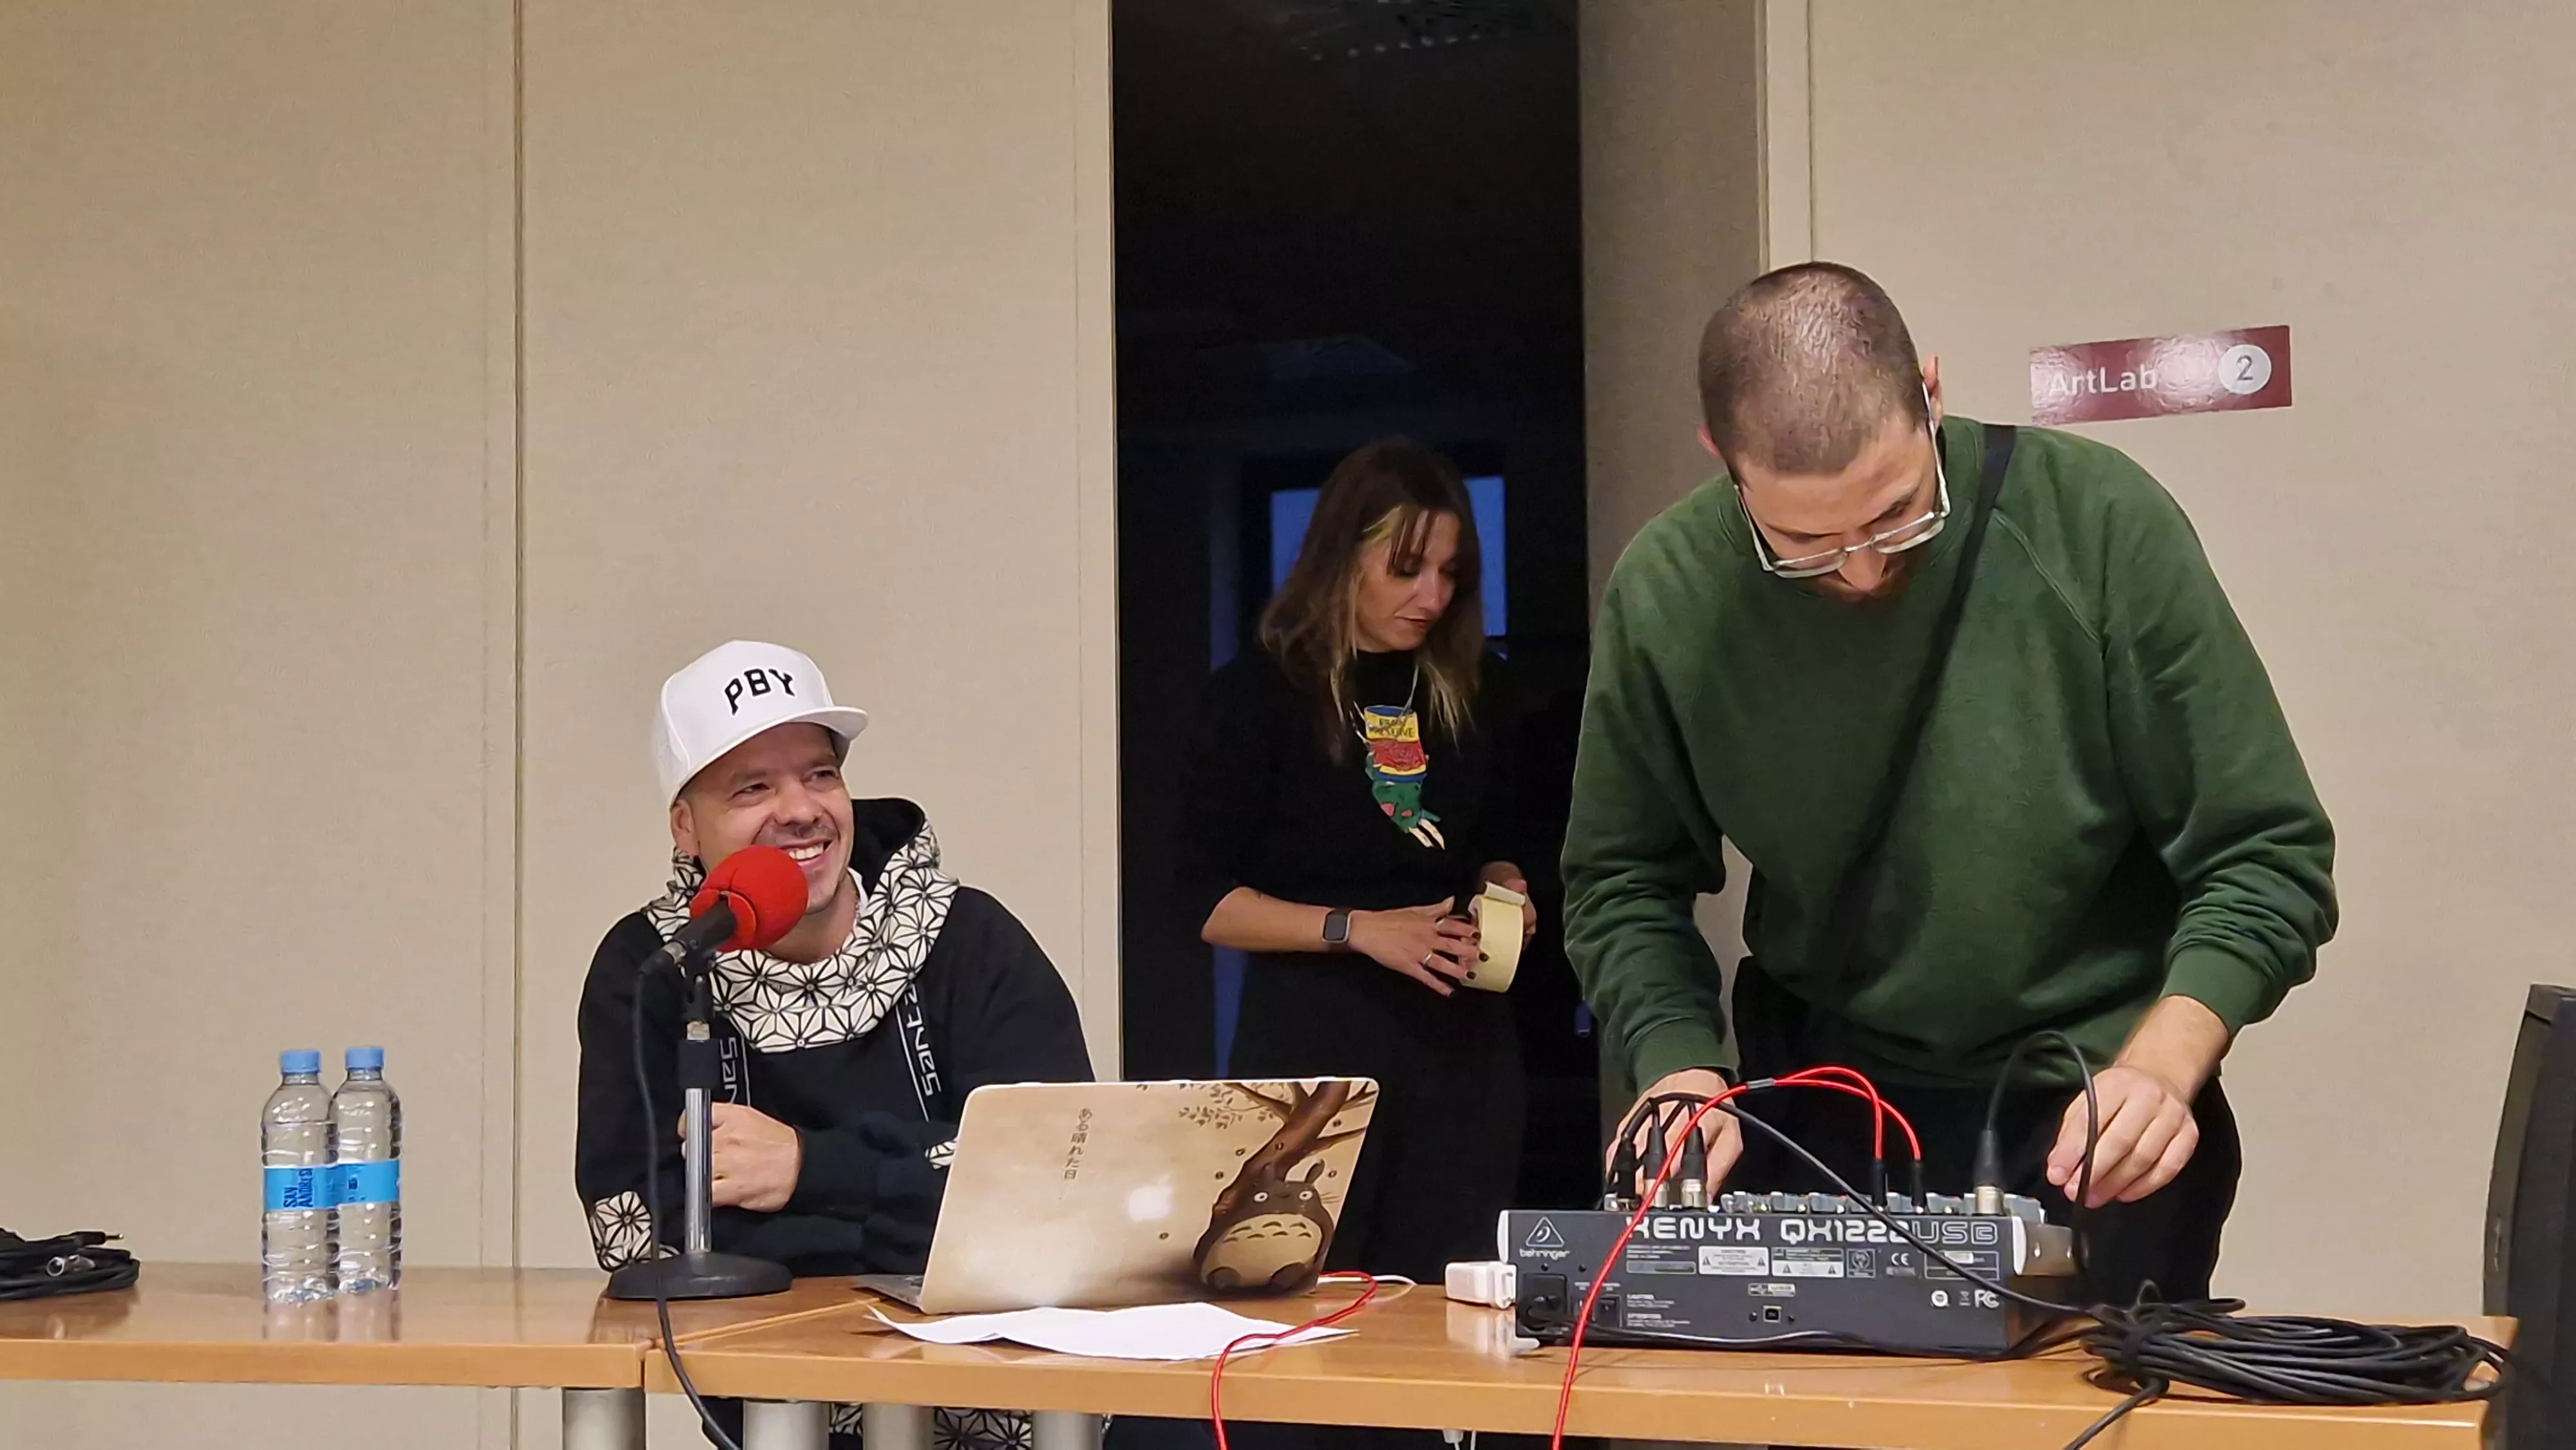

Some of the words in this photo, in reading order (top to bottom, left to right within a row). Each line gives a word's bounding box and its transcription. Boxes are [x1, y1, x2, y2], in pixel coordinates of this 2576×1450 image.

[2048, 364, 2158, 397] ArtLab
[2236, 355, 2254, 381] 2
[724, 668, 795, 715] PBY
[1065, 1107, 1092, 1180] ある晴れた日
[1520, 1248, 1570, 1260] behringer
